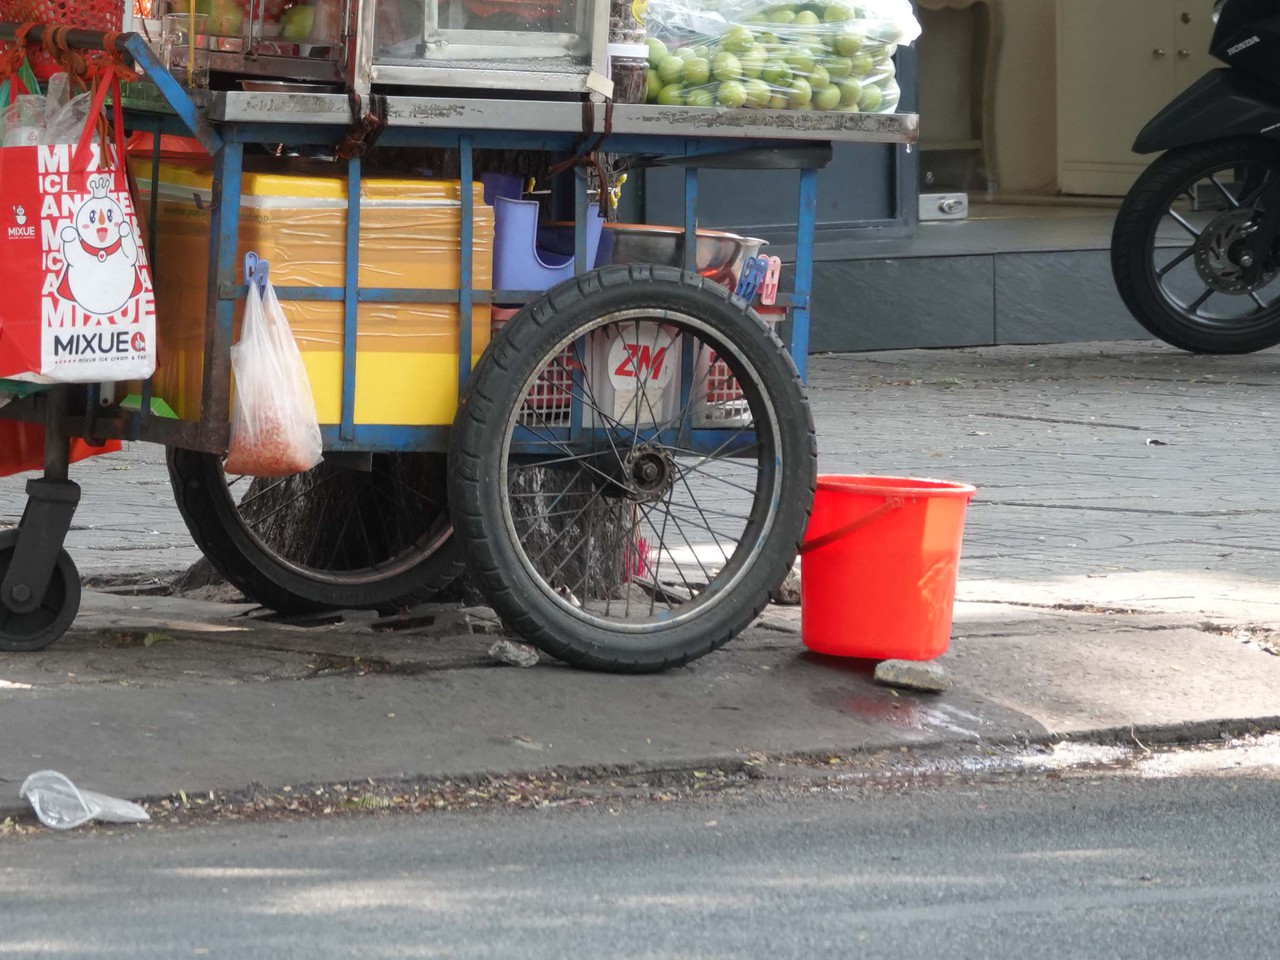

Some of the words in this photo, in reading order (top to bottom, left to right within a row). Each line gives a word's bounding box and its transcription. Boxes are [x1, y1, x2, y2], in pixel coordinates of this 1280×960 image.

[1227, 35, 1261, 56] HONDA
[8, 226, 36, 236] MIXUE
[54, 331, 130, 357] MIXUE
